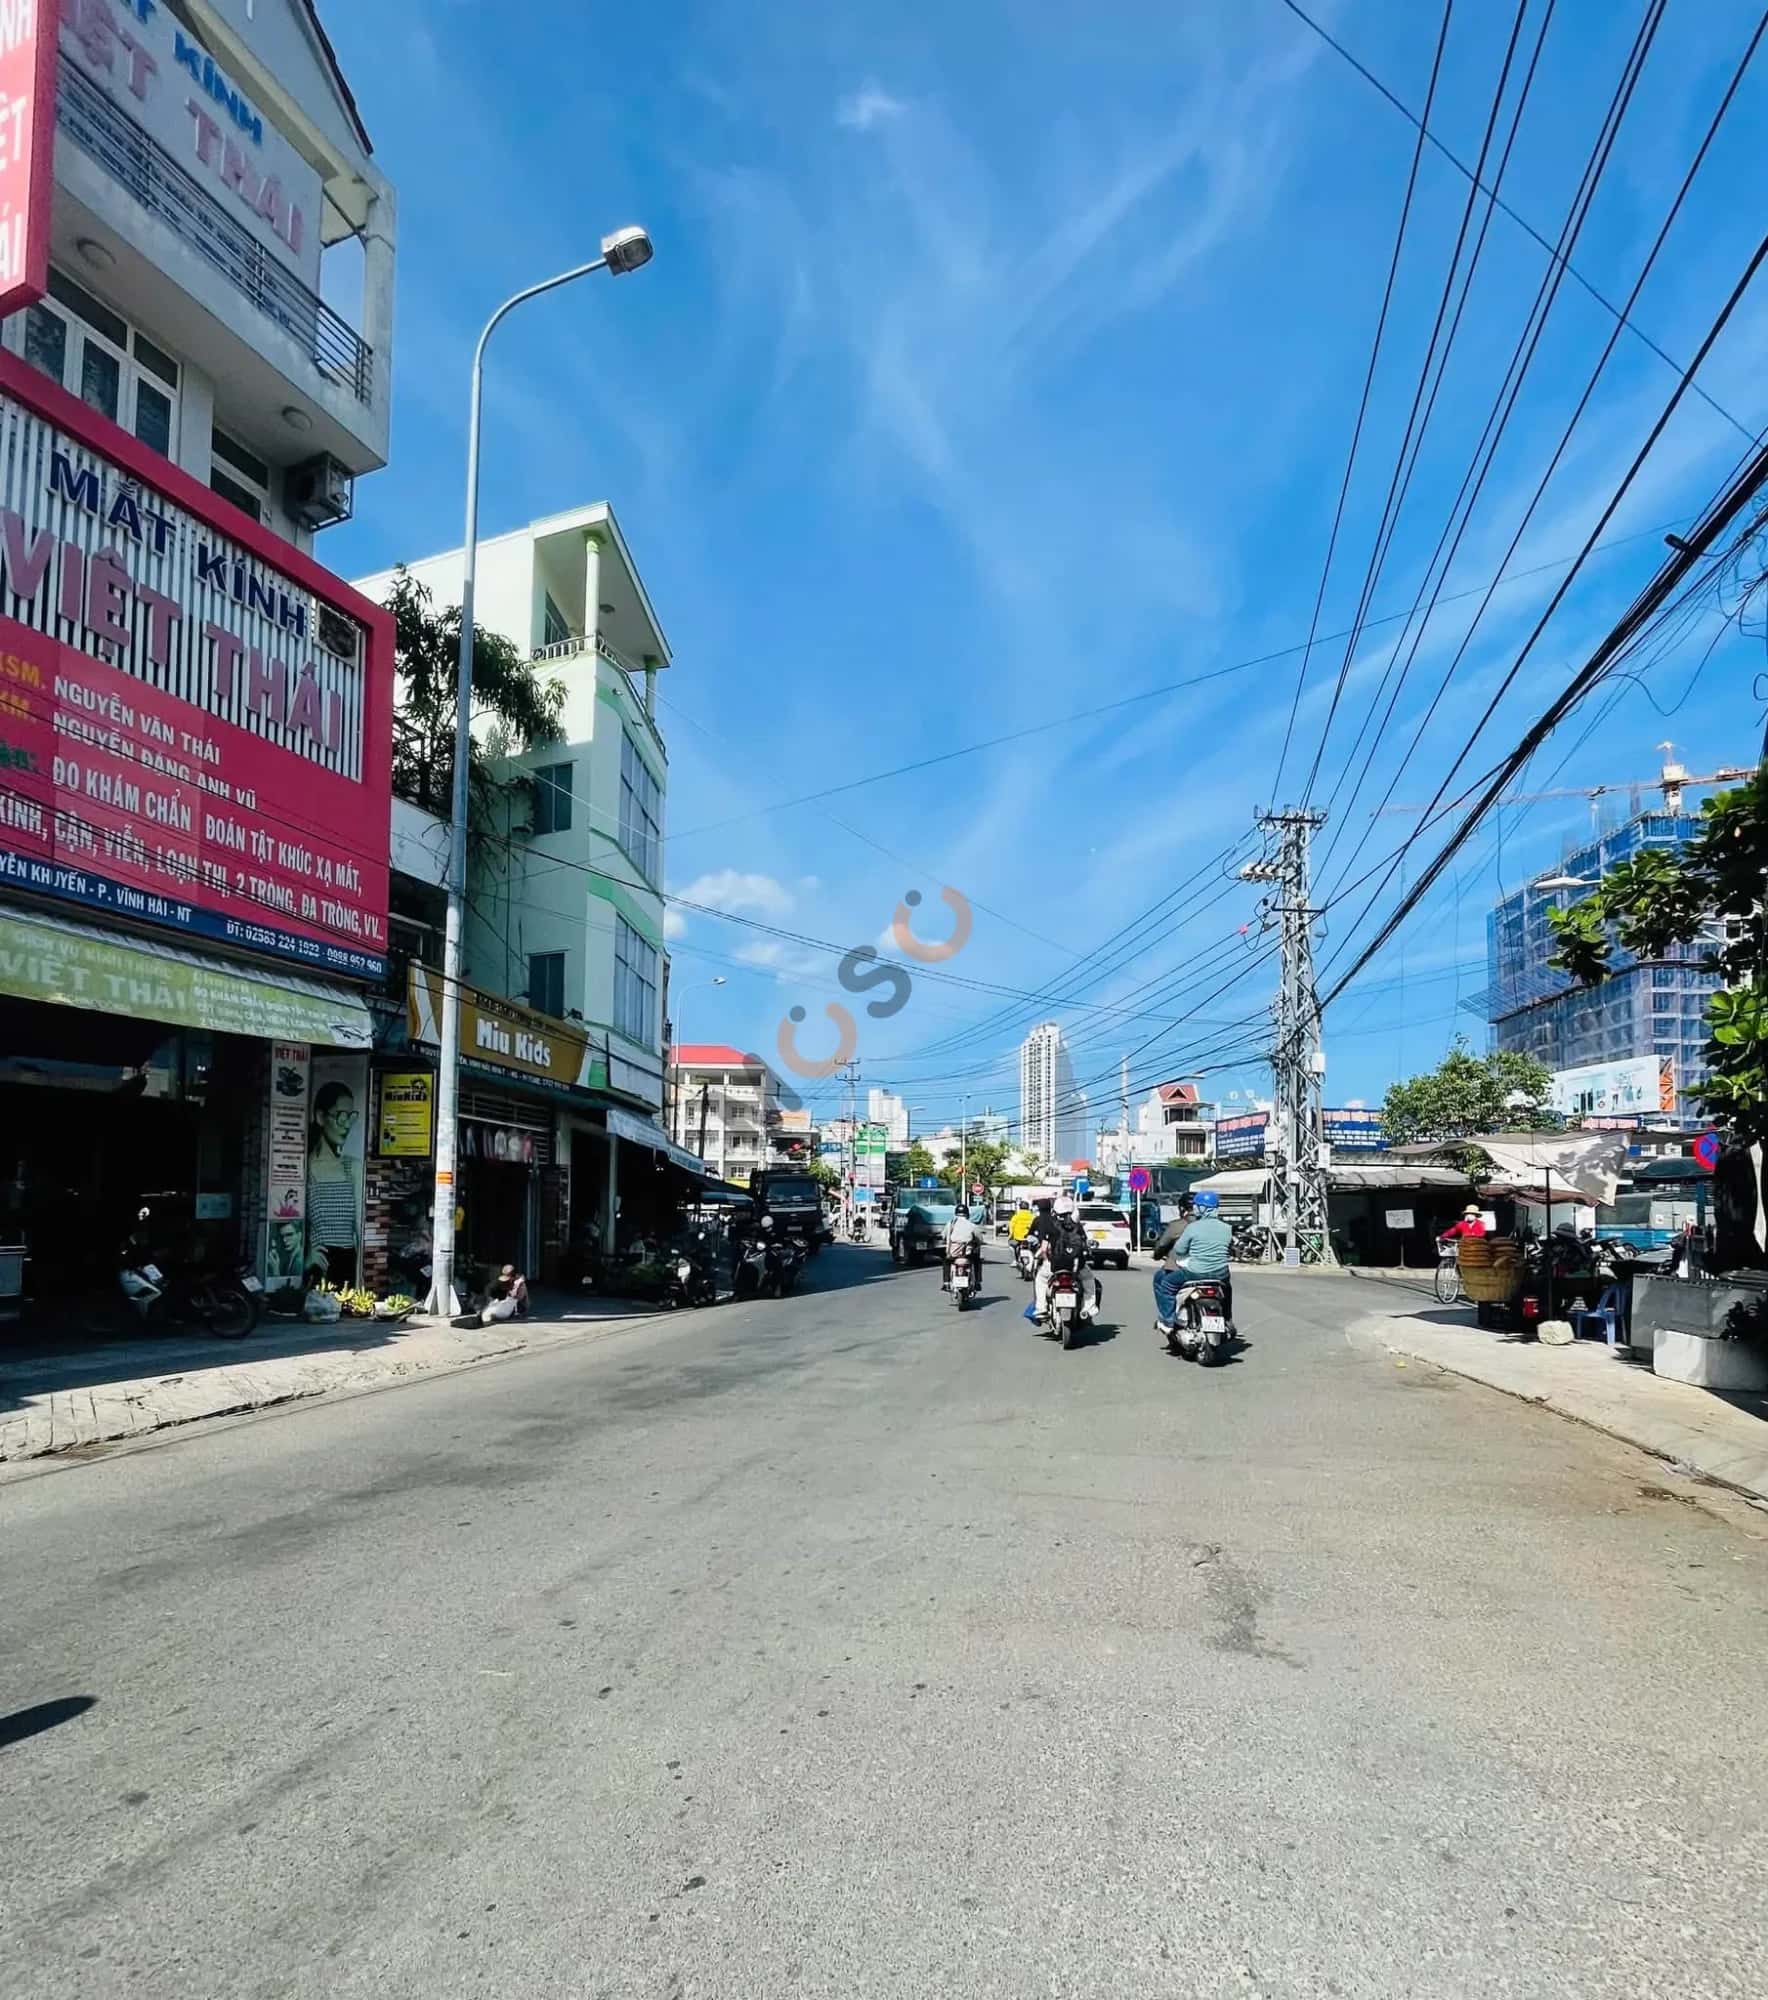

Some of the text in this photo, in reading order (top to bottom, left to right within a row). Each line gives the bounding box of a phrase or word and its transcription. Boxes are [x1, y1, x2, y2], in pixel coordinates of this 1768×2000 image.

[49, 450, 308, 641] MẮT KÍNH
[0, 508, 343, 754] VIỆT THÁI
[54, 674, 135, 728] NGUYỄN
[139, 712, 175, 745] VĂN
[180, 731, 221, 766] THÁI
[86, 768, 140, 814] KHÁM
[205, 813, 246, 852] ĐOÁN
[250, 829, 275, 863] TẬT
[278, 841, 313, 875] KHÚC
[316, 855, 332, 888] XẠ
[117, 886, 144, 911] VĨNH
[177, 904, 192, 923] NT
[235, 872, 247, 895] 2
[302, 893, 317, 919] ĐA
[321, 899, 362, 939] TRÒNG,
[514, 1031, 552, 1069] Kids
